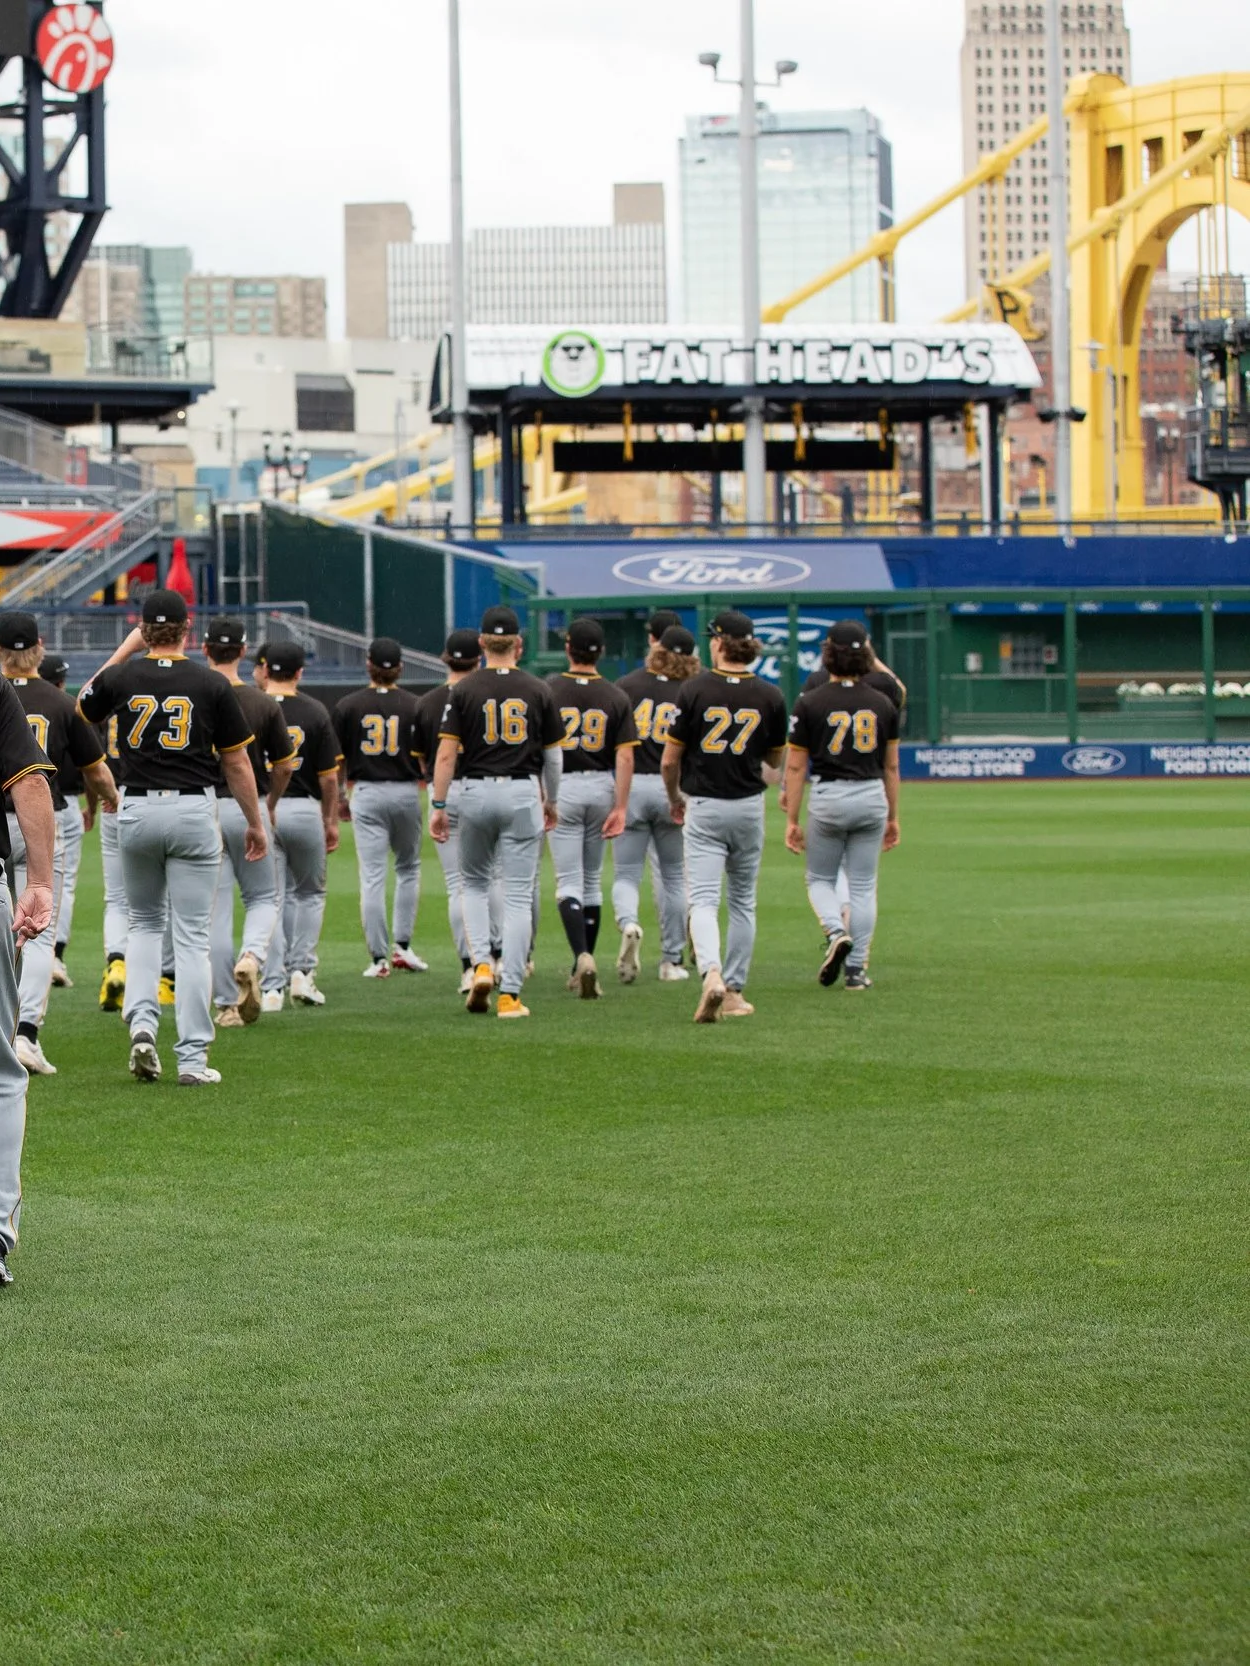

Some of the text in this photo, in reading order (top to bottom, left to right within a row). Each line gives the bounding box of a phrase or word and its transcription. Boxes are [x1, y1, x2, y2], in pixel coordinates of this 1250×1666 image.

[623, 339, 992, 384] FAT HEAD'S
[649, 556, 774, 584] Ford
[127, 695, 194, 749] 73
[360, 714, 400, 757] 31
[482, 698, 528, 745] 16
[559, 706, 609, 752] 29
[700, 706, 762, 756] 27
[827, 709, 878, 756] 78
[915, 747, 1036, 764] NEIGHBORHOOD
[930, 762, 1024, 776] FORD STORE
[1072, 752, 1115, 771] Ford
[1164, 760, 1207, 774] FORD
